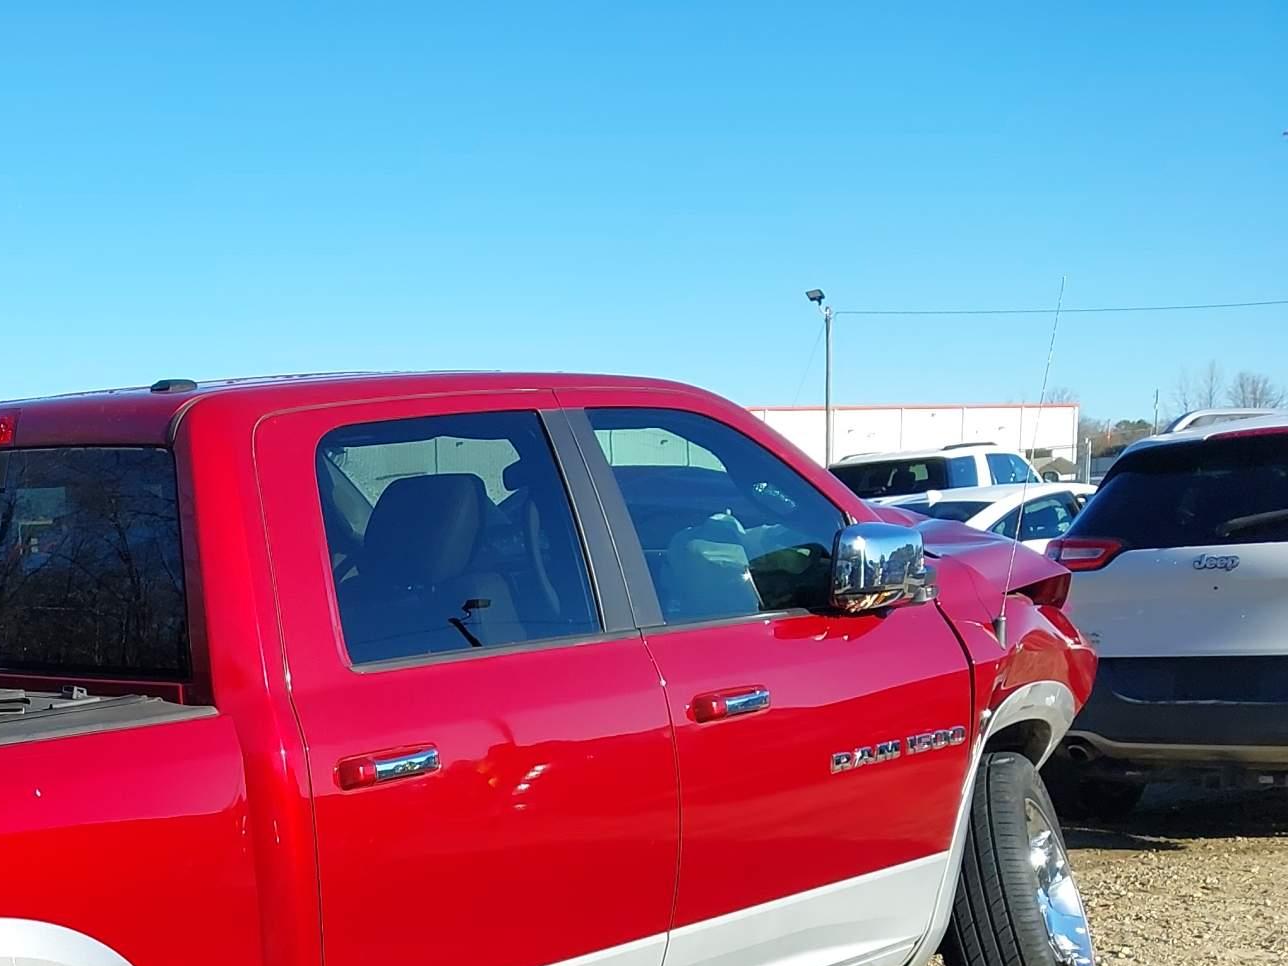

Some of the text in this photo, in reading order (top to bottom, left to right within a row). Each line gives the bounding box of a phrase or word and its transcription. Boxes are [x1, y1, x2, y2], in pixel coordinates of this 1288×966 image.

[1193, 553, 1240, 572] Jeep
[830, 726, 966, 774] RAM 1500
